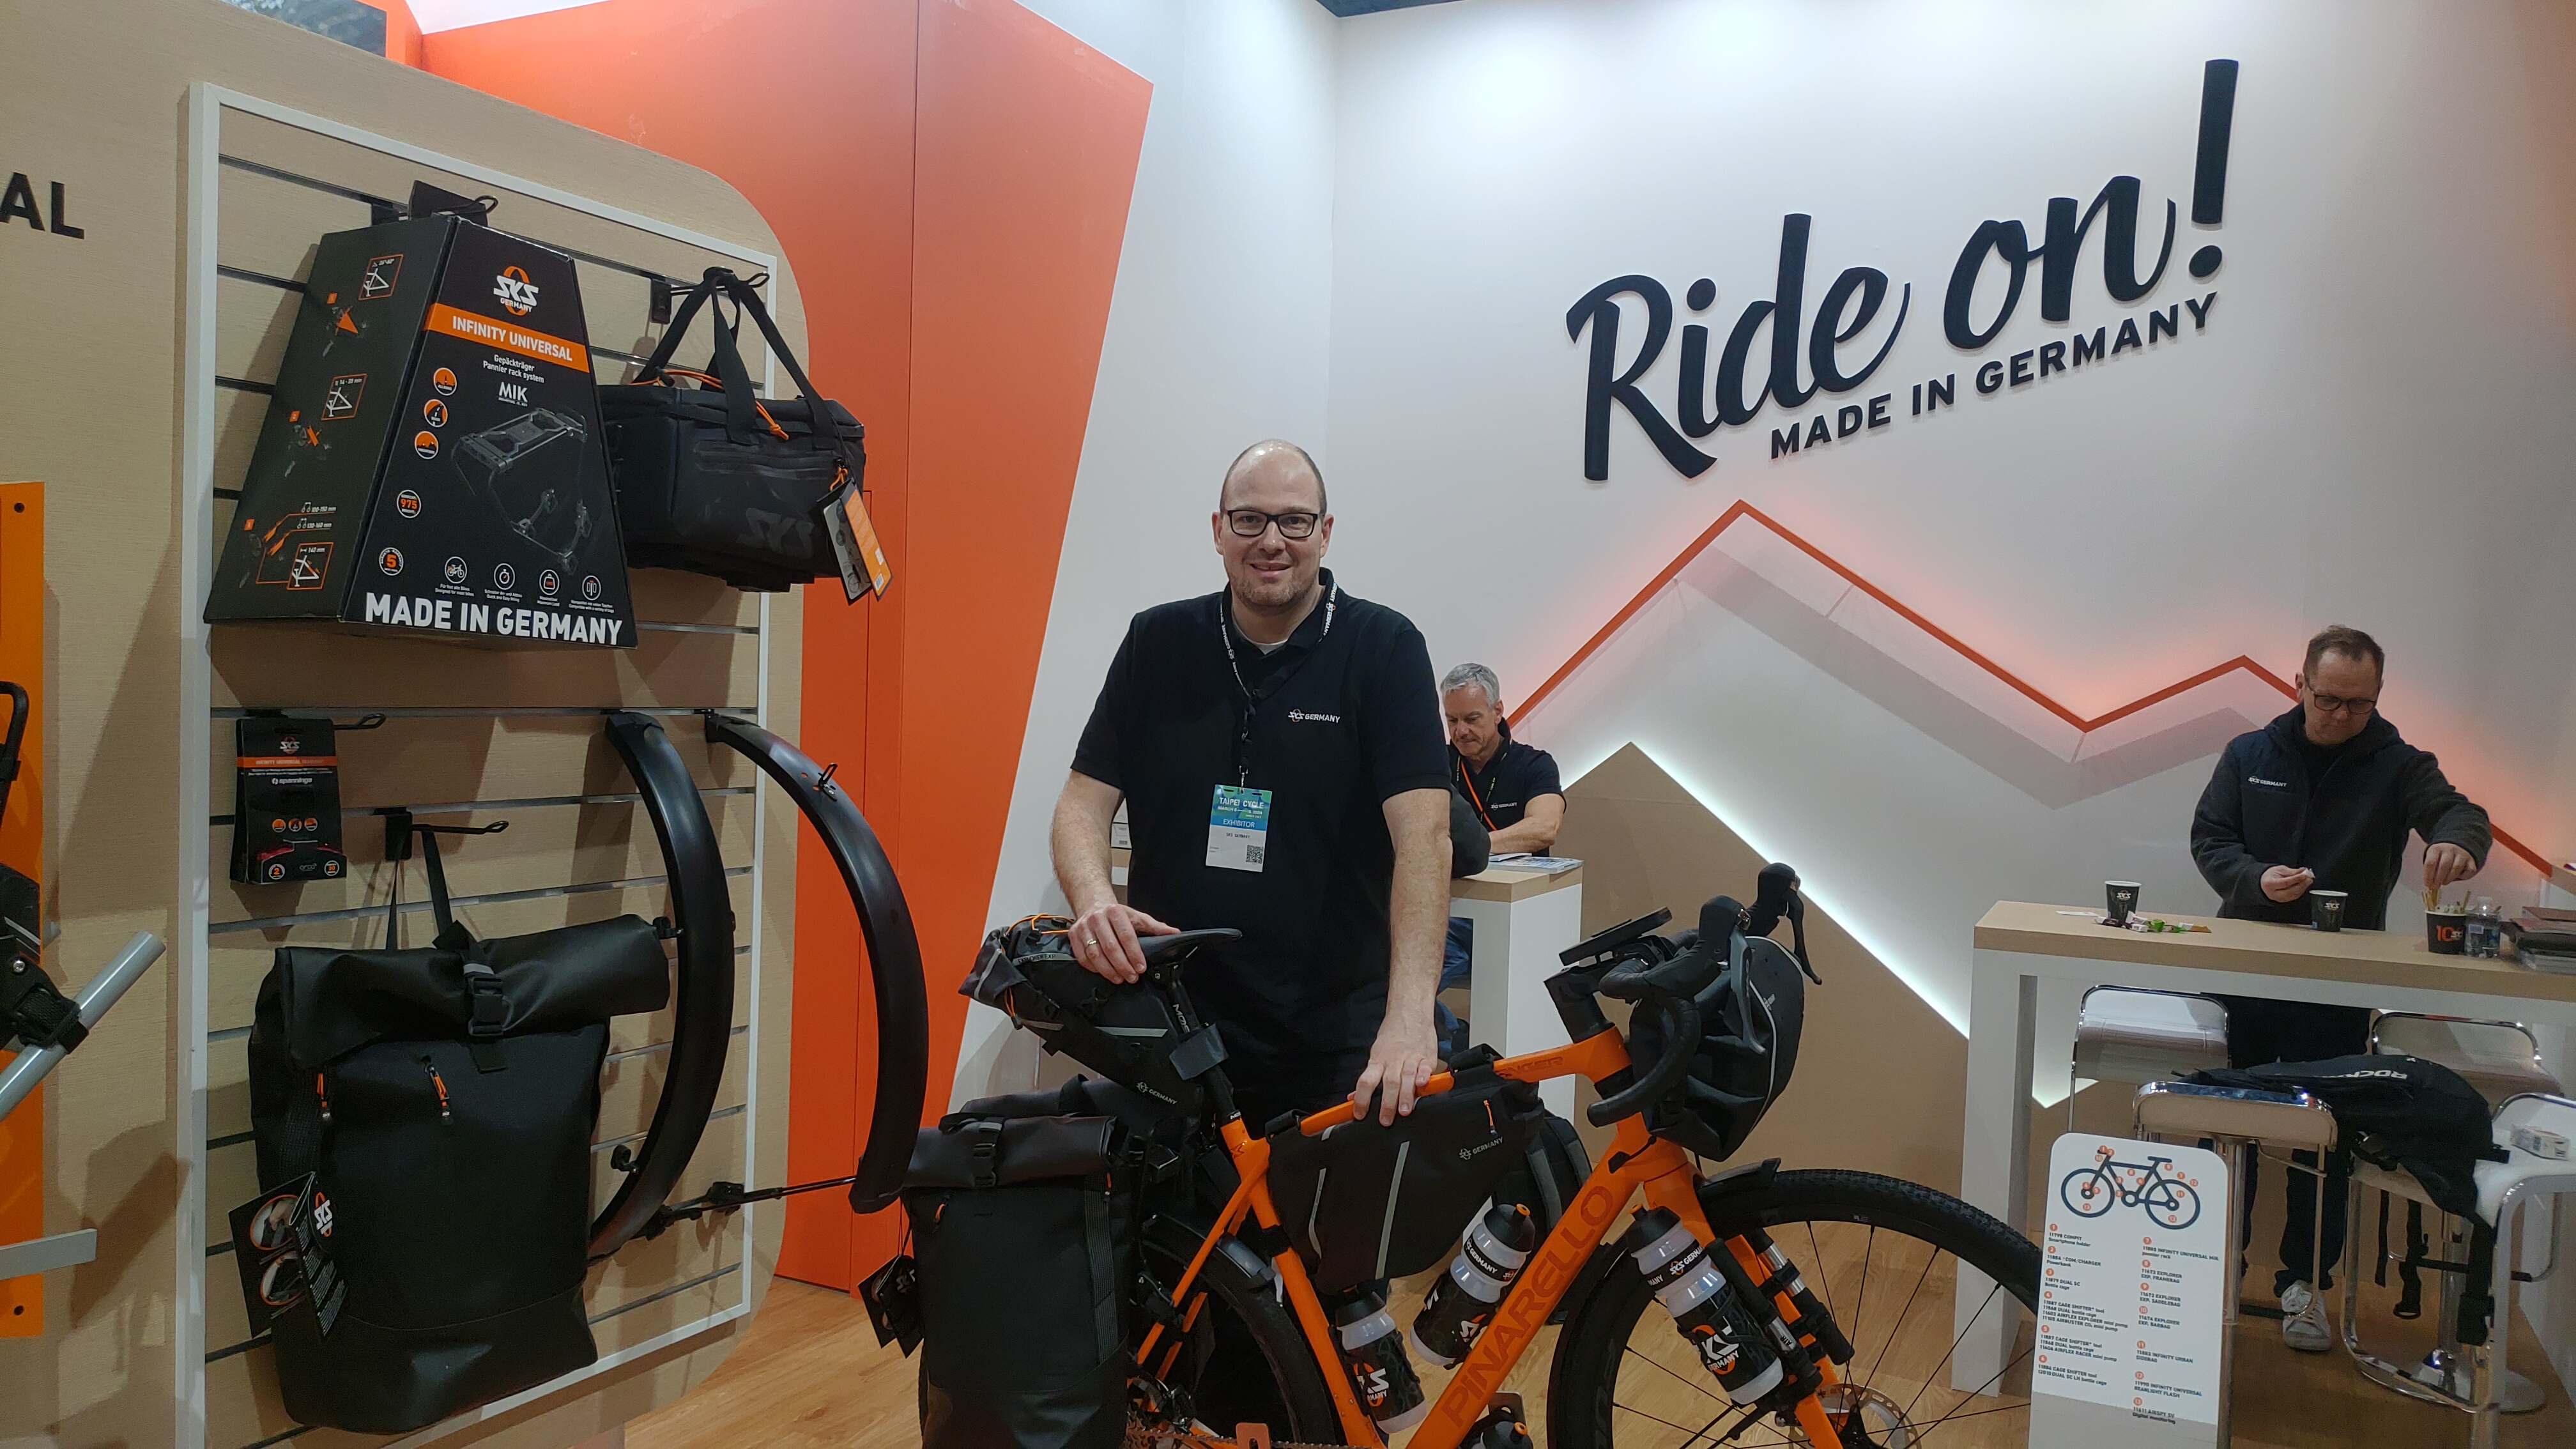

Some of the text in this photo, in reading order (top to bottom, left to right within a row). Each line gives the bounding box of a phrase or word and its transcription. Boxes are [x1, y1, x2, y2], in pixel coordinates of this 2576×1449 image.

[1565, 58, 2239, 481] Ride on!
[494, 275, 539, 306] SKS
[500, 298, 532, 312] GERMANY
[453, 316, 573, 361] INFINITY UNIVERSAL
[483, 361, 544, 383] Pannier rack system
[494, 355, 535, 372] Gepäckträger
[1770, 292, 2217, 460] MADE IN GERMANY
[499, 381, 528, 402] MIK
[401, 498, 417, 510] 975
[387, 554, 397, 568] 5
[365, 592, 622, 645] MADE IN GERMANY
[1305, 714, 1341, 723] GERMANY
[280, 741, 300, 749] SKS
[1220, 797, 1264, 809] TAIPEI CYCLE
[1223, 819, 1255, 827] EXHIBITOR
[1173, 1004, 1190, 1033] MOS
[1149, 1089, 1177, 1105] GERMANY
[1472, 1137, 1503, 1154] GERMANY
[1469, 1248, 1498, 1273] GERMANY
[1669, 1245, 1704, 1275] SKS GERMA
[2174, 1388, 2202, 1396] UNIVERSAL
